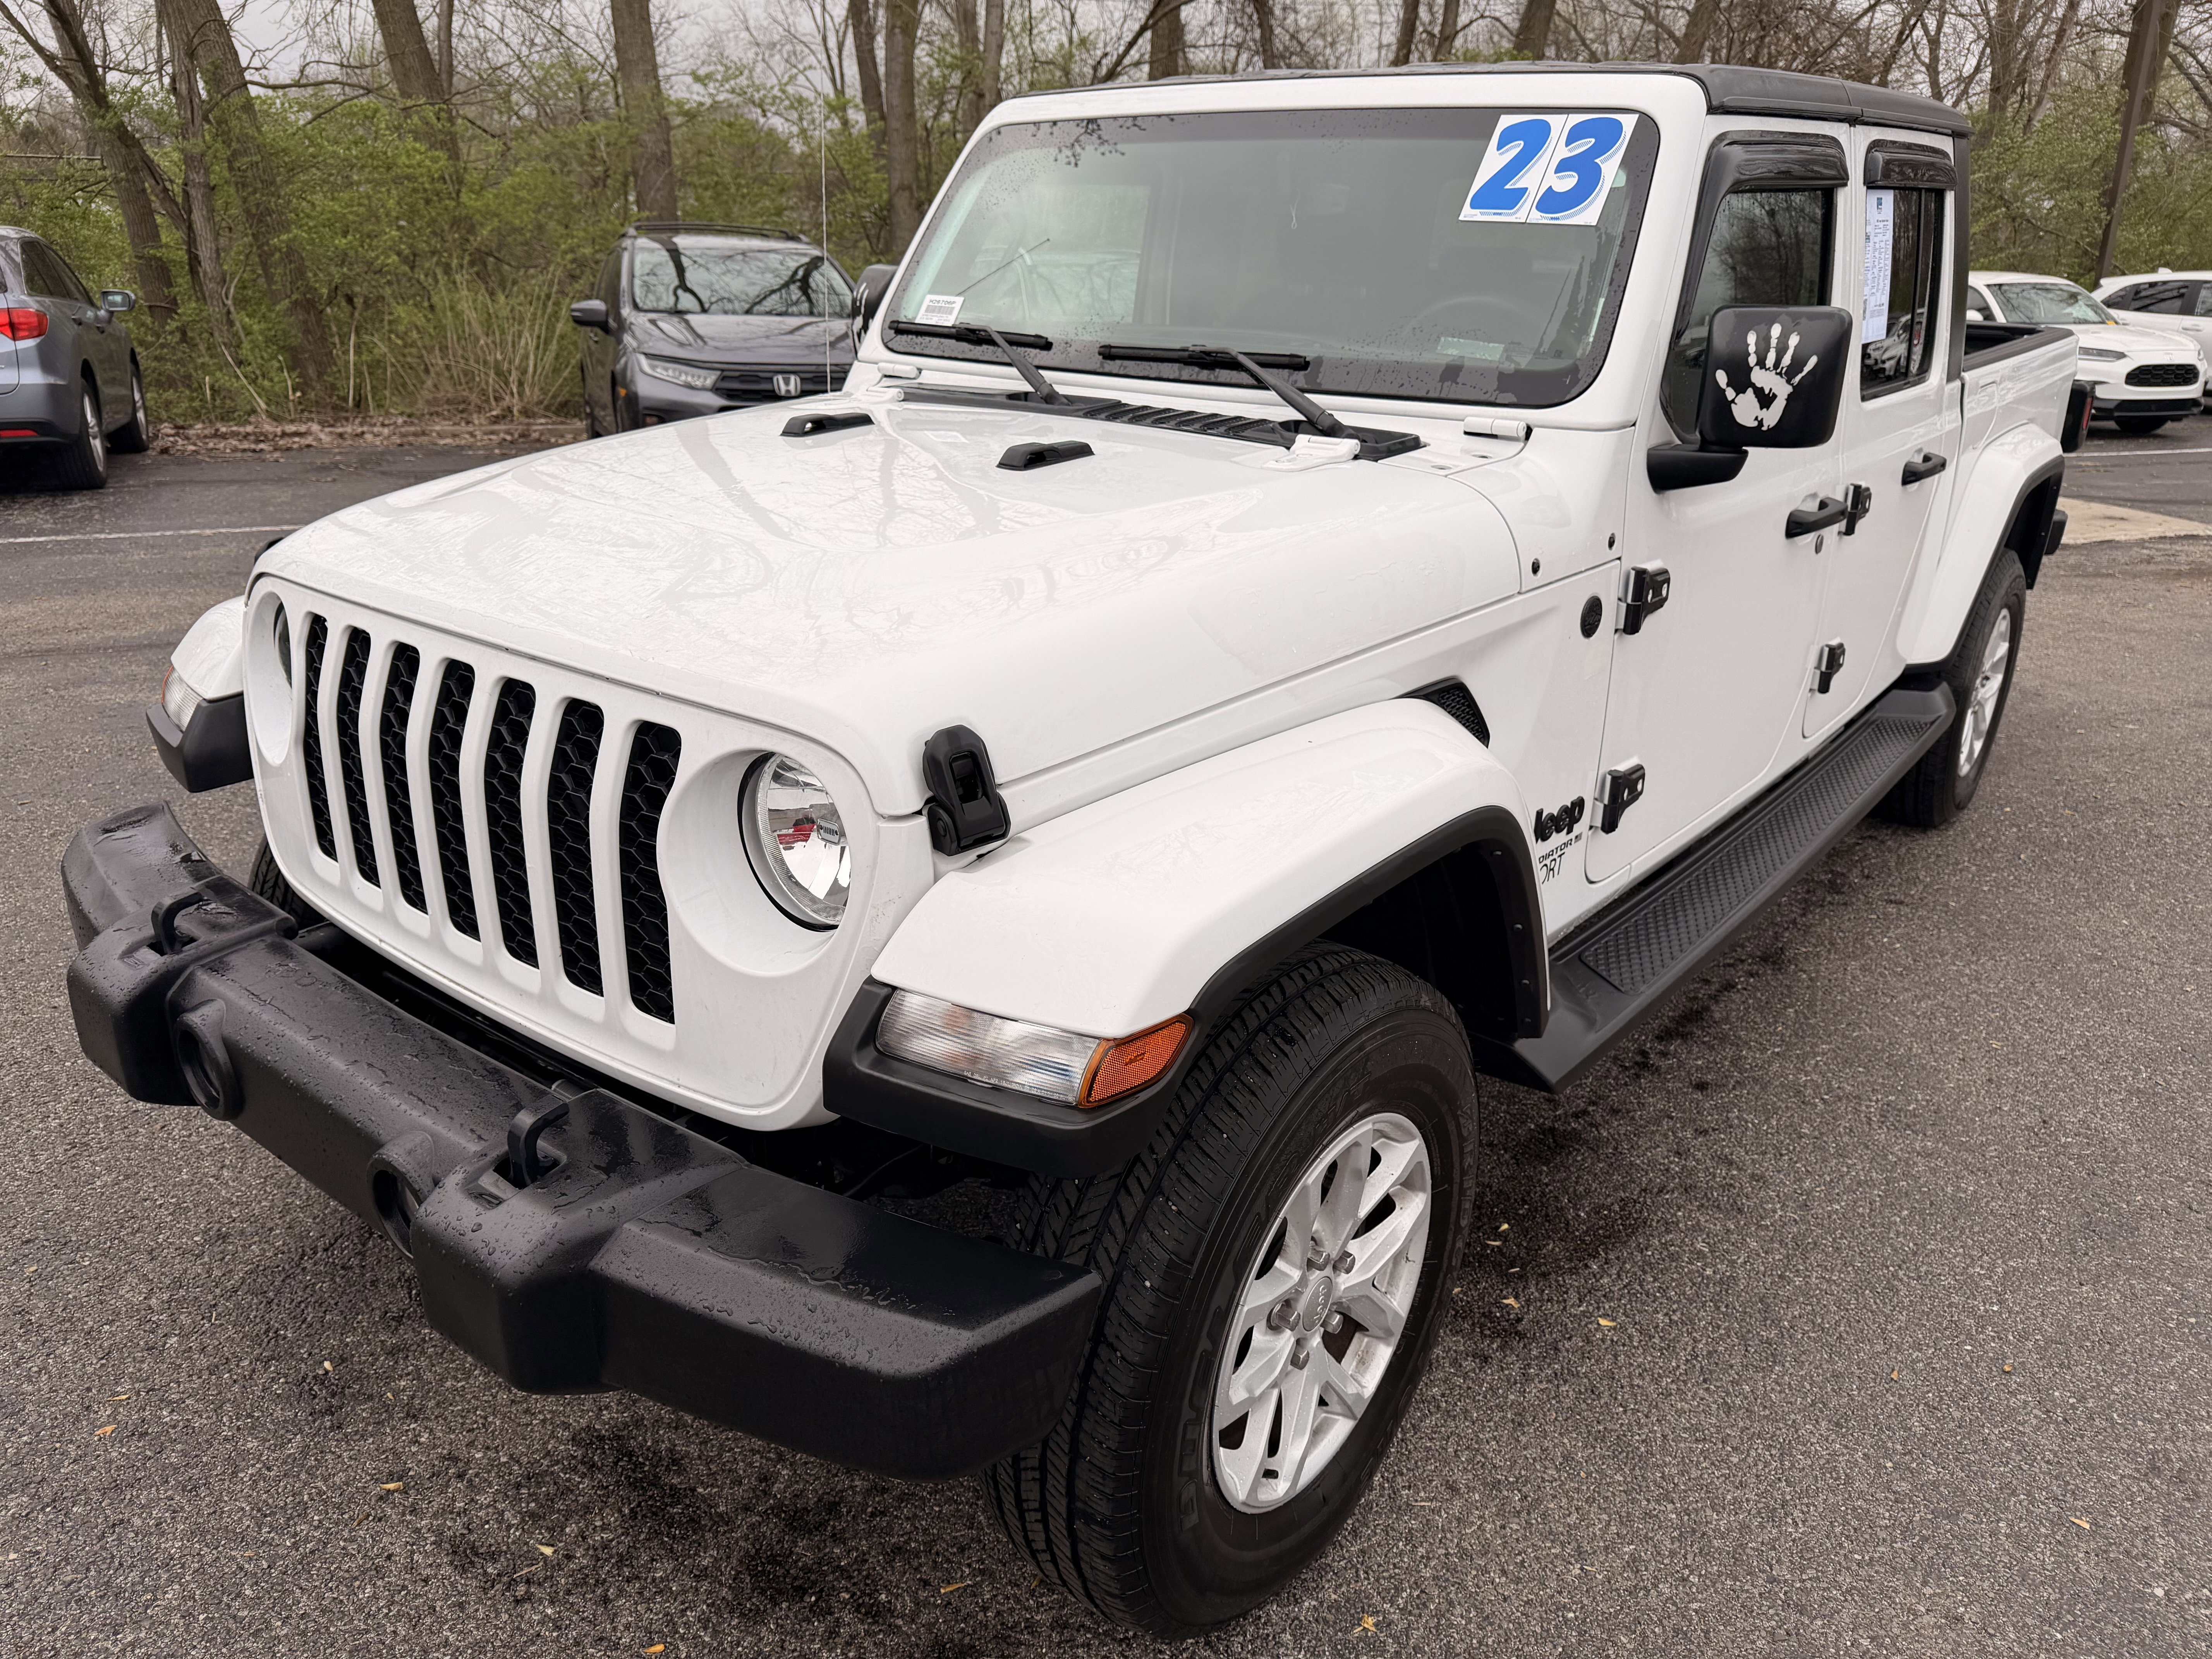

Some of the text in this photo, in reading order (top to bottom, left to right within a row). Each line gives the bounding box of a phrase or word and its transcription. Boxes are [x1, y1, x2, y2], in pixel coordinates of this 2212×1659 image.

[1470, 118, 1625, 221] 23
[1538, 838, 1573, 864] DIATOR
[1540, 851, 1565, 884] ORT
